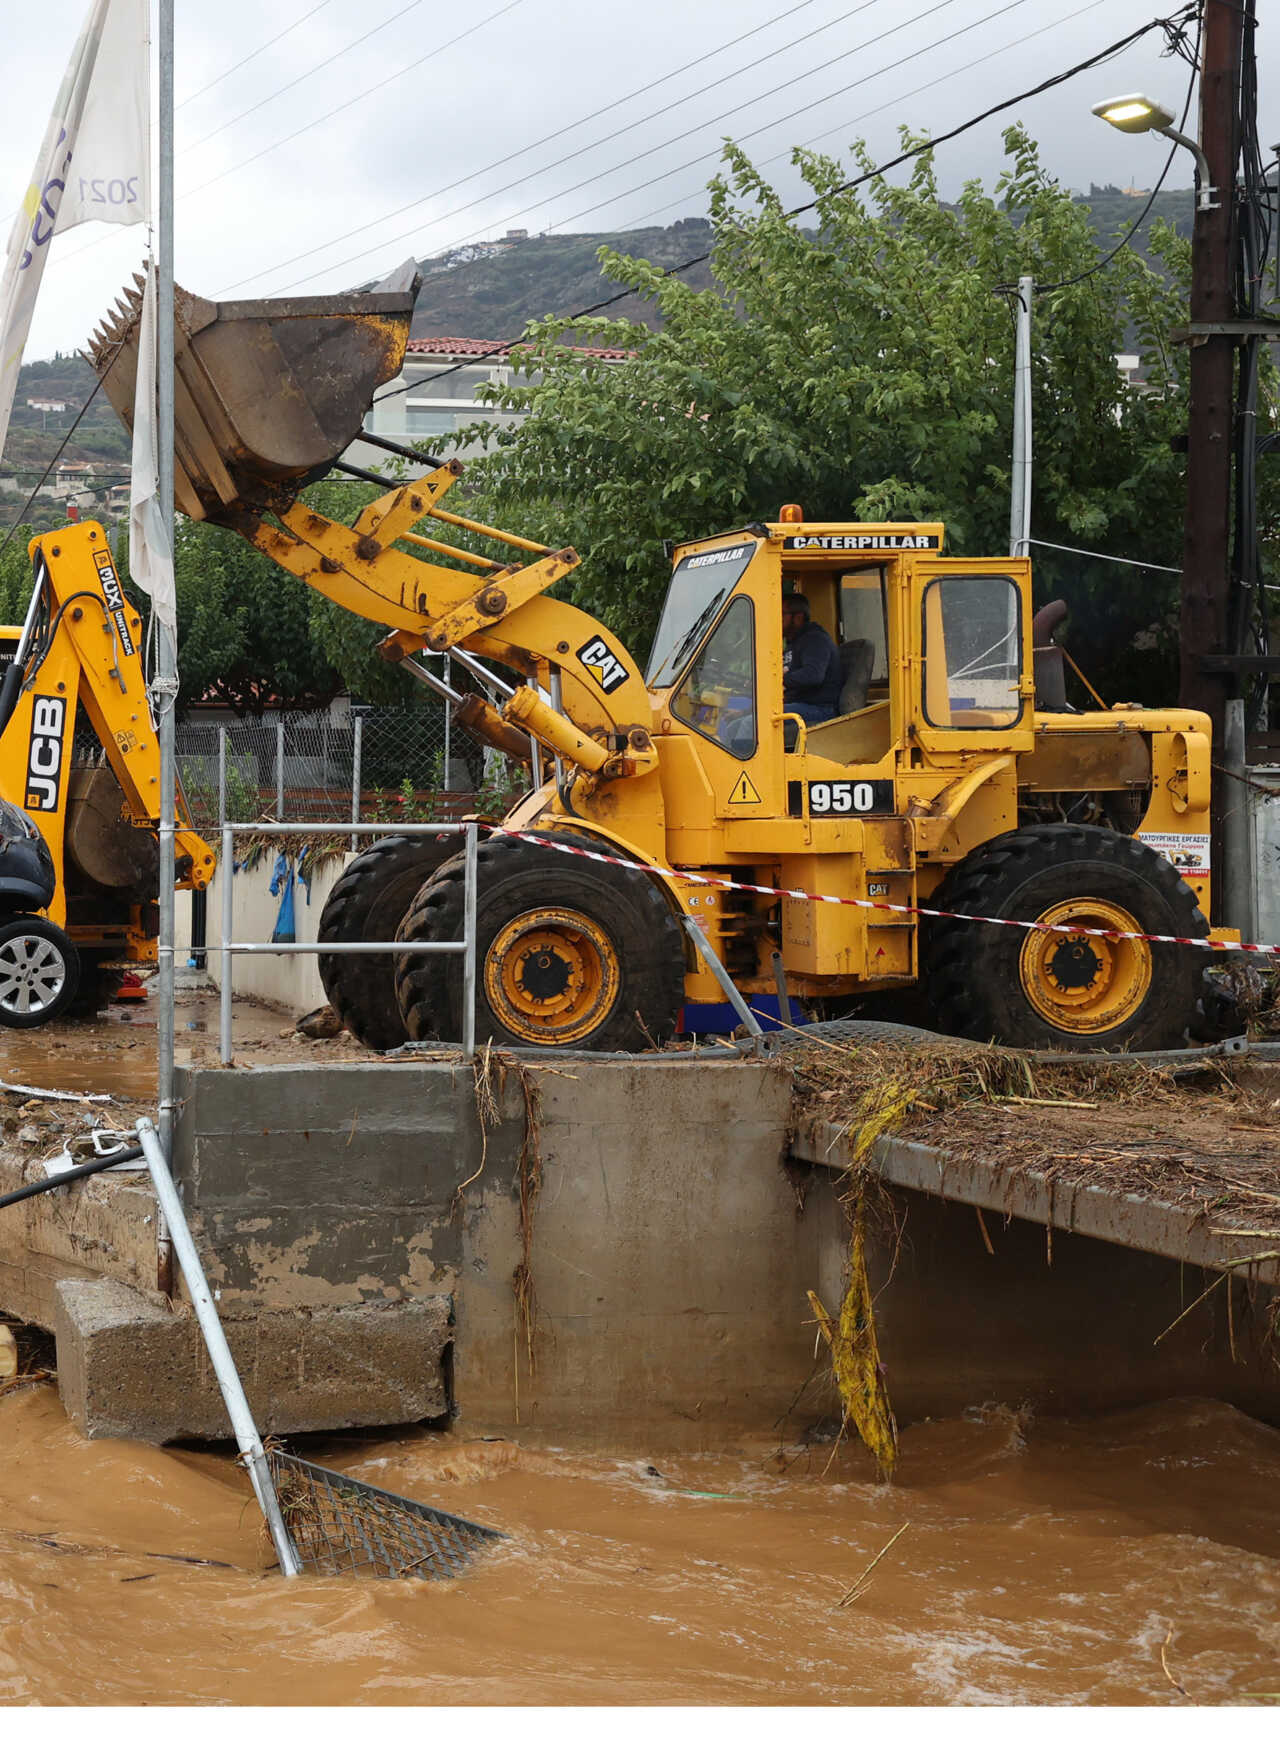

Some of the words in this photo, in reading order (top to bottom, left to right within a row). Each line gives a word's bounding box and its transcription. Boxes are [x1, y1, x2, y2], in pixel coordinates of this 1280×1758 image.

[793, 536, 929, 549] CATERPILLAR
[687, 548, 745, 569] CATERPILLAR
[99, 567, 122, 607] 3CX
[115, 611, 133, 656] UNITRACK
[581, 641, 627, 688] CAT
[29, 698, 64, 809] JCB
[810, 783, 873, 812] 950
[688, 897, 699, 906] CE
[869, 884, 888, 896] CAT
